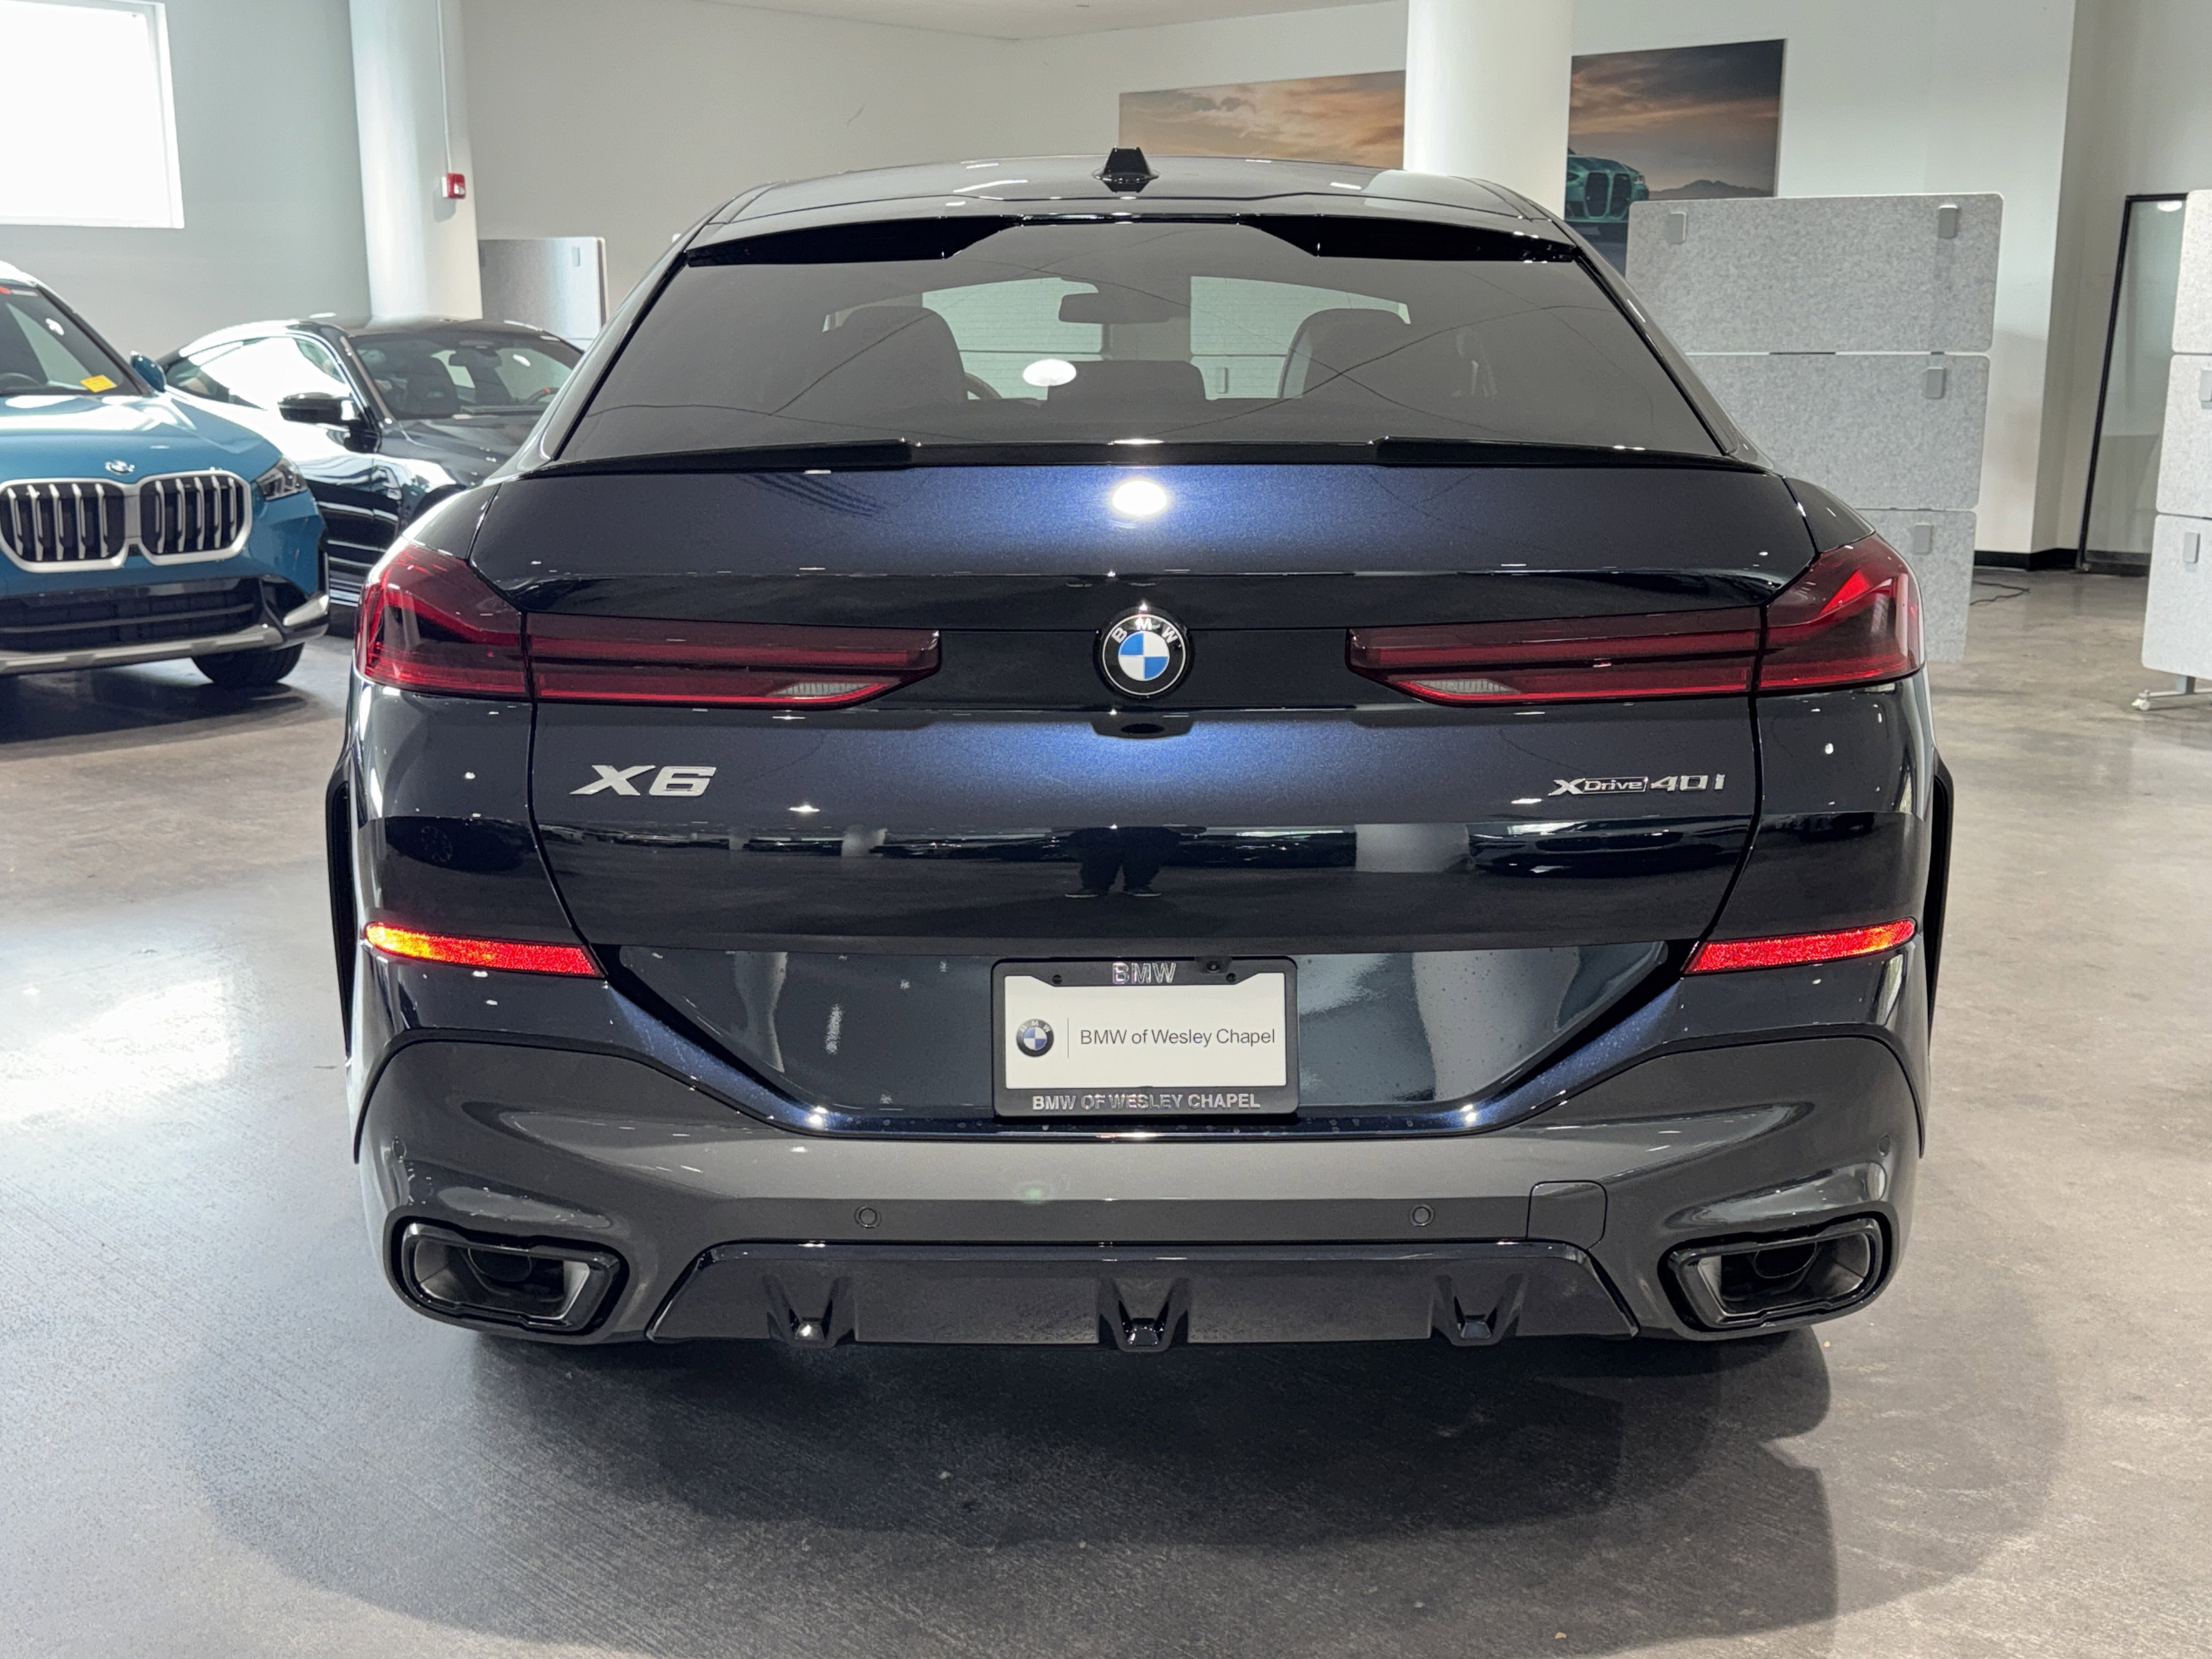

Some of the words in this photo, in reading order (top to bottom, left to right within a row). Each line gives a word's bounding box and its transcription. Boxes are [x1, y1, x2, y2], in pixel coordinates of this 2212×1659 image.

[1111, 617, 1178, 644] BMW
[569, 765, 716, 796] X6
[1112, 962, 1176, 984] BMW
[1080, 1029, 1127, 1045] BMW
[1131, 1029, 1148, 1044] of
[1151, 1029, 1212, 1048] Wesley
[1216, 1028, 1276, 1047] Chapel
[1032, 1096, 1076, 1110] BMW
[1081, 1095, 1105, 1110] OF
[1108, 1094, 1183, 1109] WESLEY
[1188, 1093, 1261, 1109] CHAPEL
